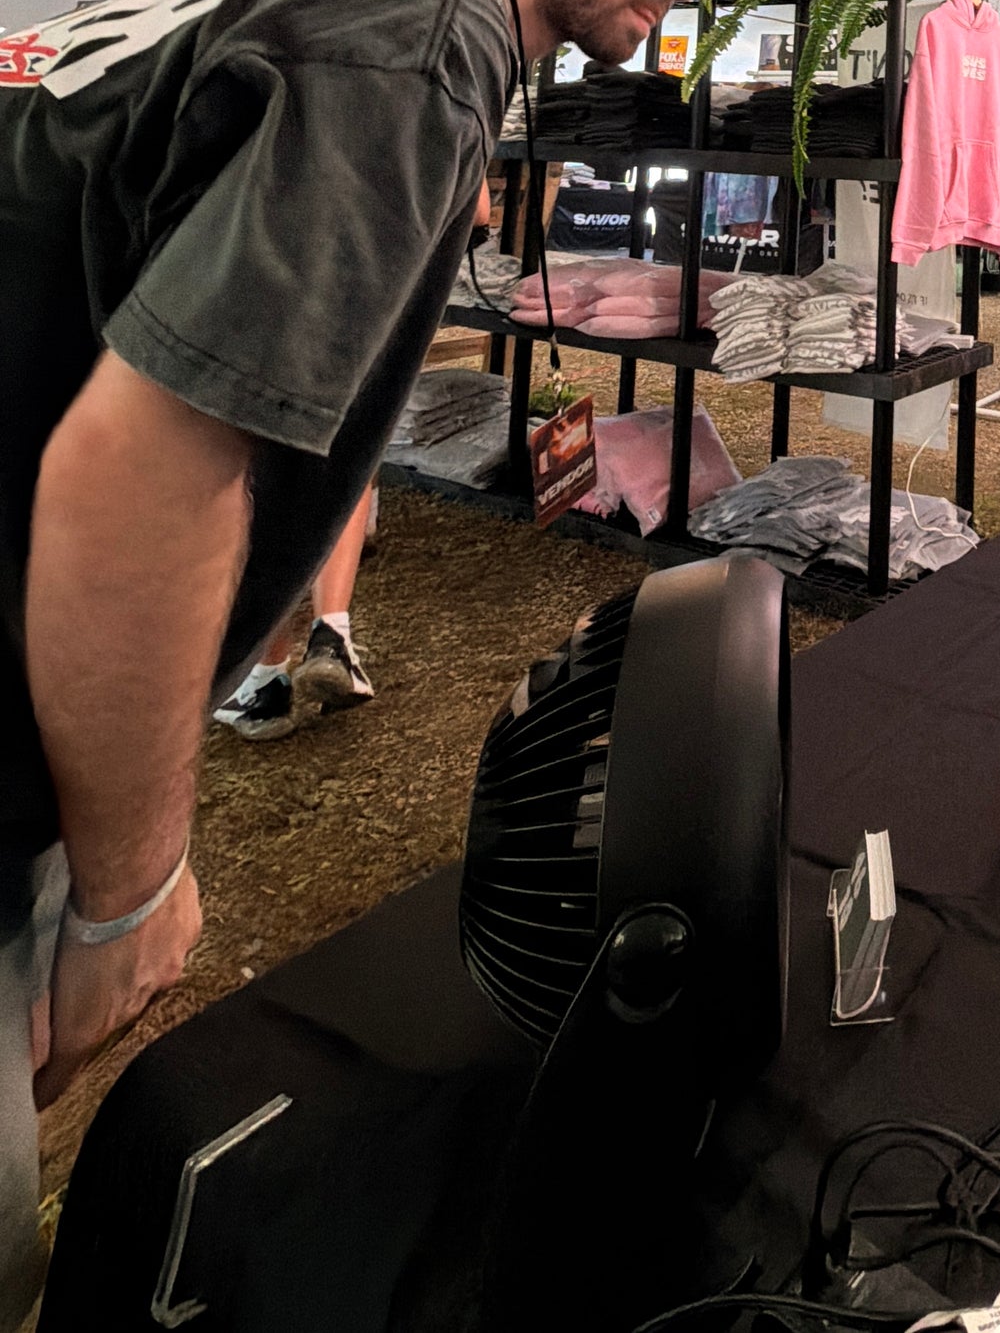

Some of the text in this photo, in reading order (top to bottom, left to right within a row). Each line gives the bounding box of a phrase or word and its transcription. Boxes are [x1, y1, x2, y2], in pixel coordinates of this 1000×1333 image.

[659, 52, 677, 63] FOX
[759, 250, 779, 258] ONE
[538, 456, 594, 506] VENDOR
